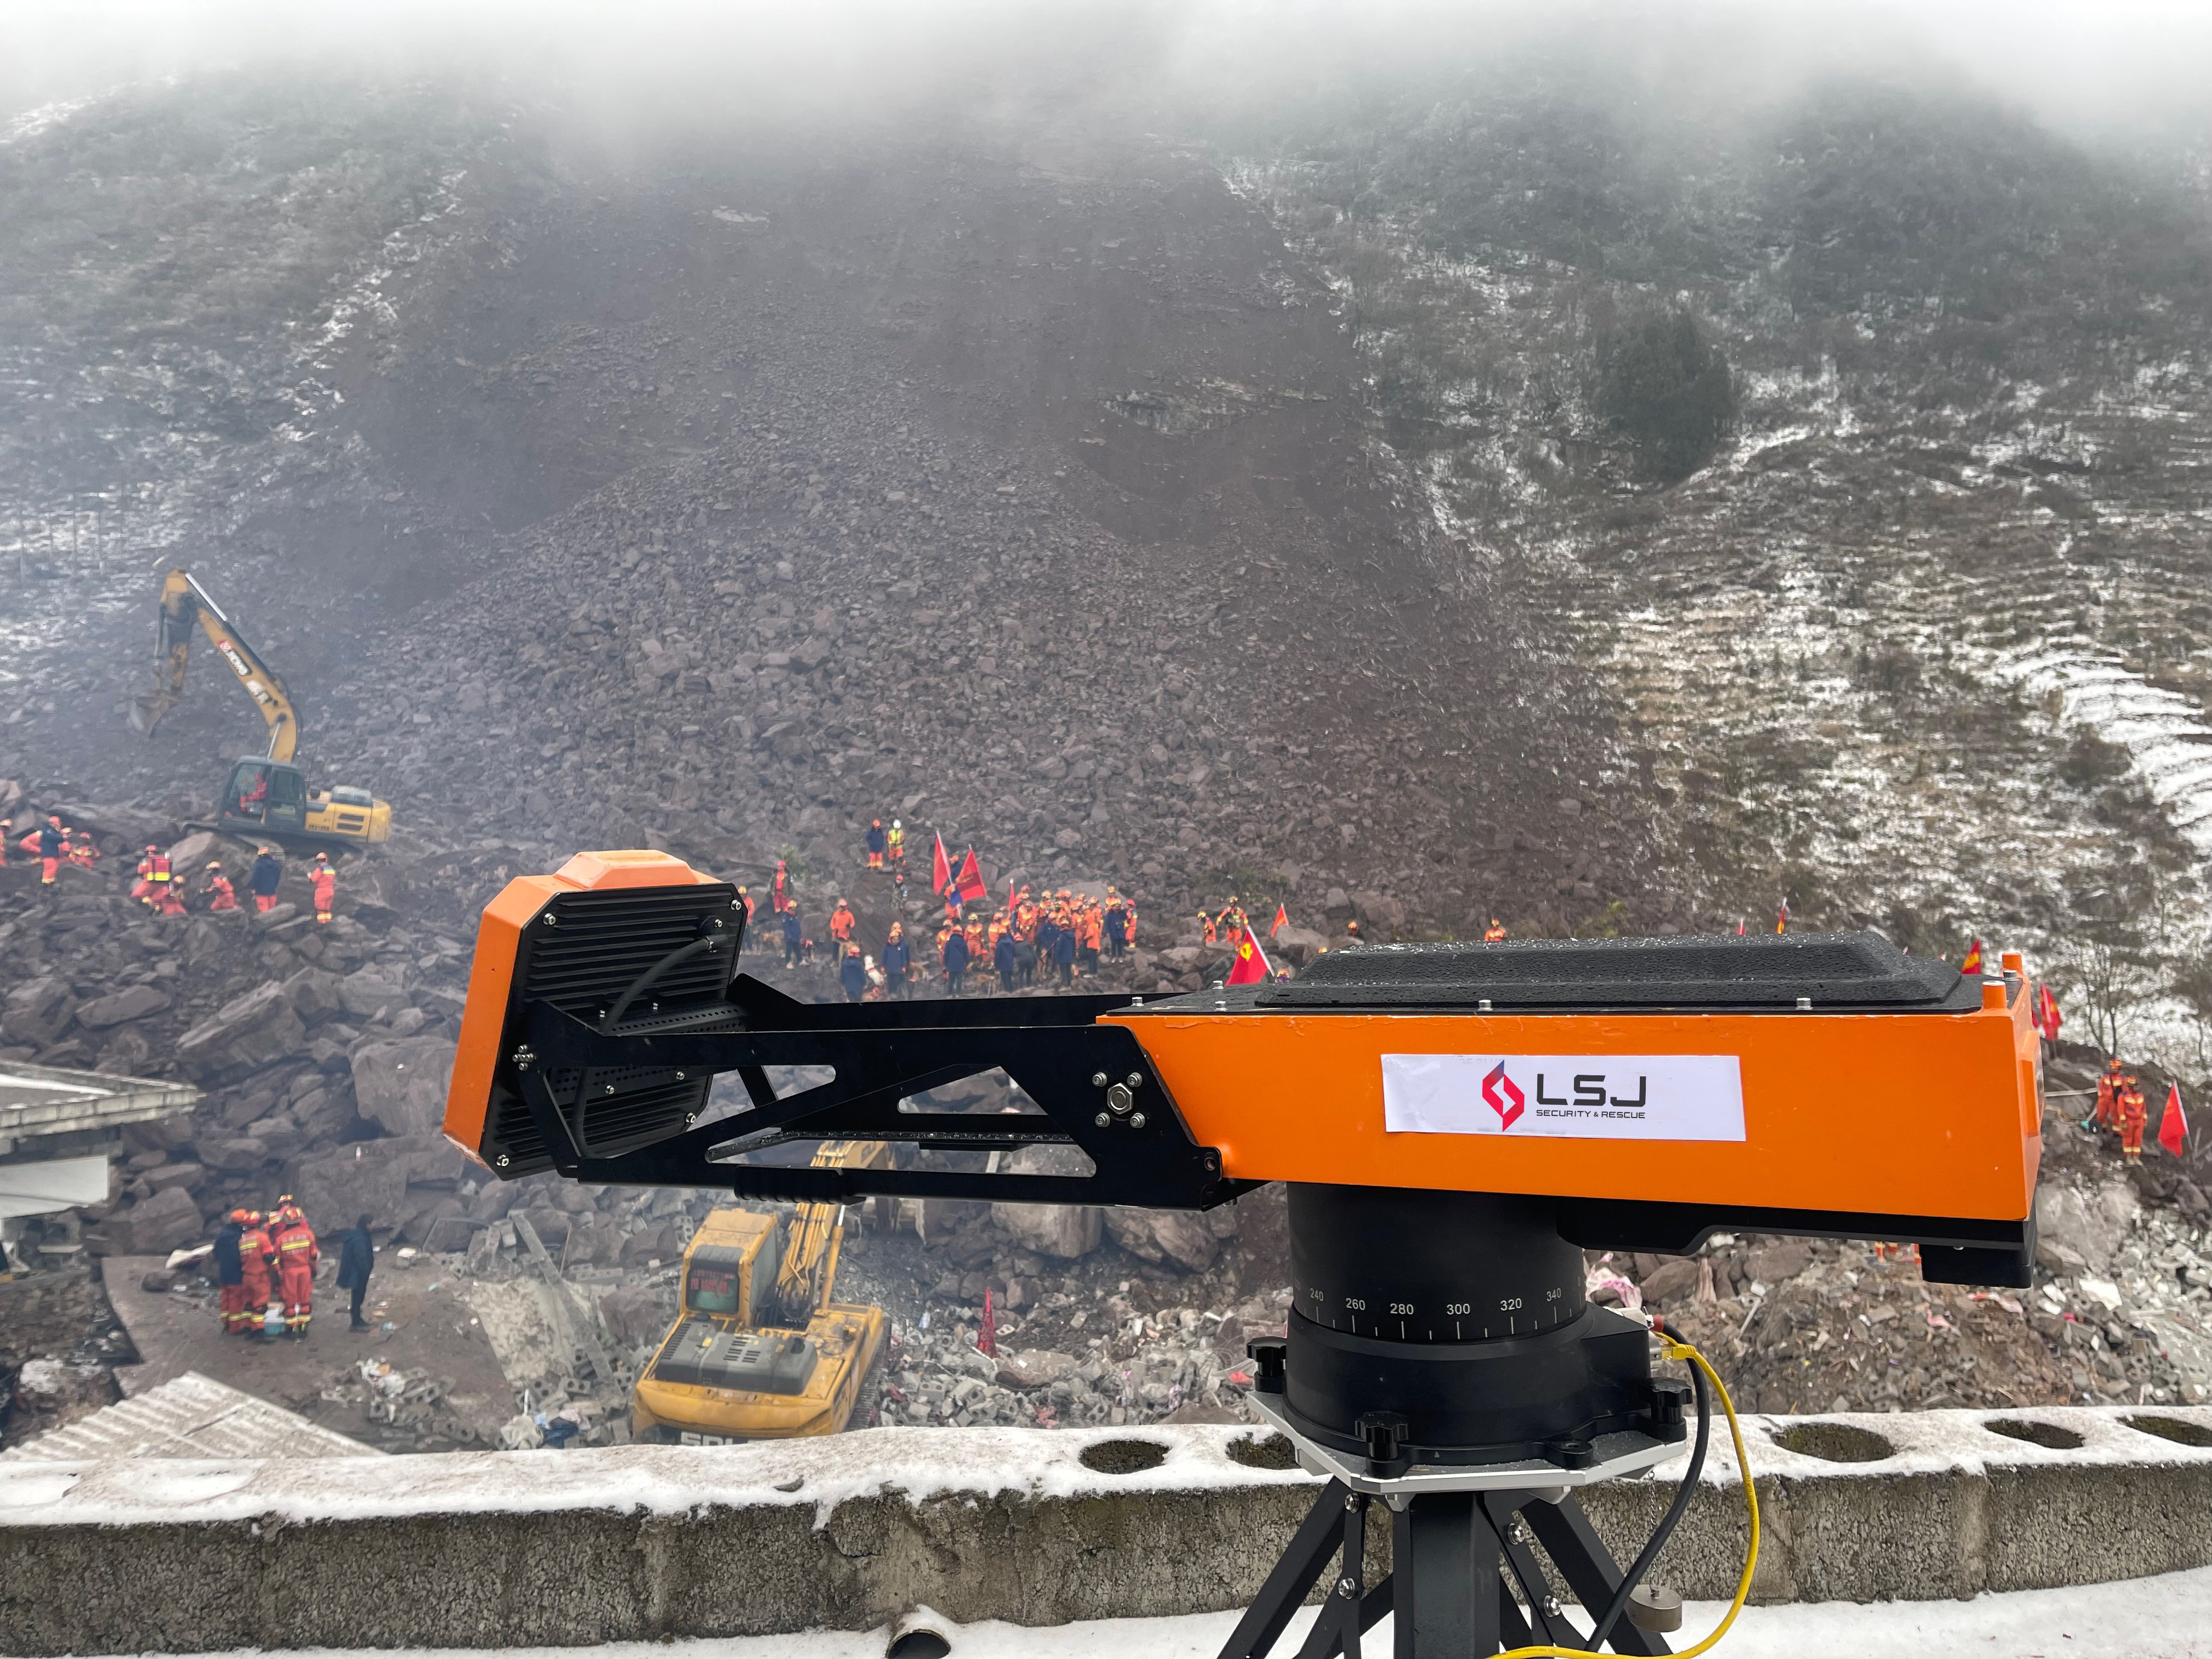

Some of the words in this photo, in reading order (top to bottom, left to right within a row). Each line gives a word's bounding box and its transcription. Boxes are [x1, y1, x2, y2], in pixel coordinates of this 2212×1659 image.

[1536, 1073, 1646, 1108] LSJ
[1536, 1109, 1592, 1118] SECURITY
[1310, 1287, 1324, 1302] 240
[1345, 1297, 1365, 1311] 260
[1390, 1303, 1414, 1315] 280
[1446, 1303, 1470, 1315] 300
[1500, 1297, 1522, 1311] 320
[1546, 1287, 1561, 1302] 340
